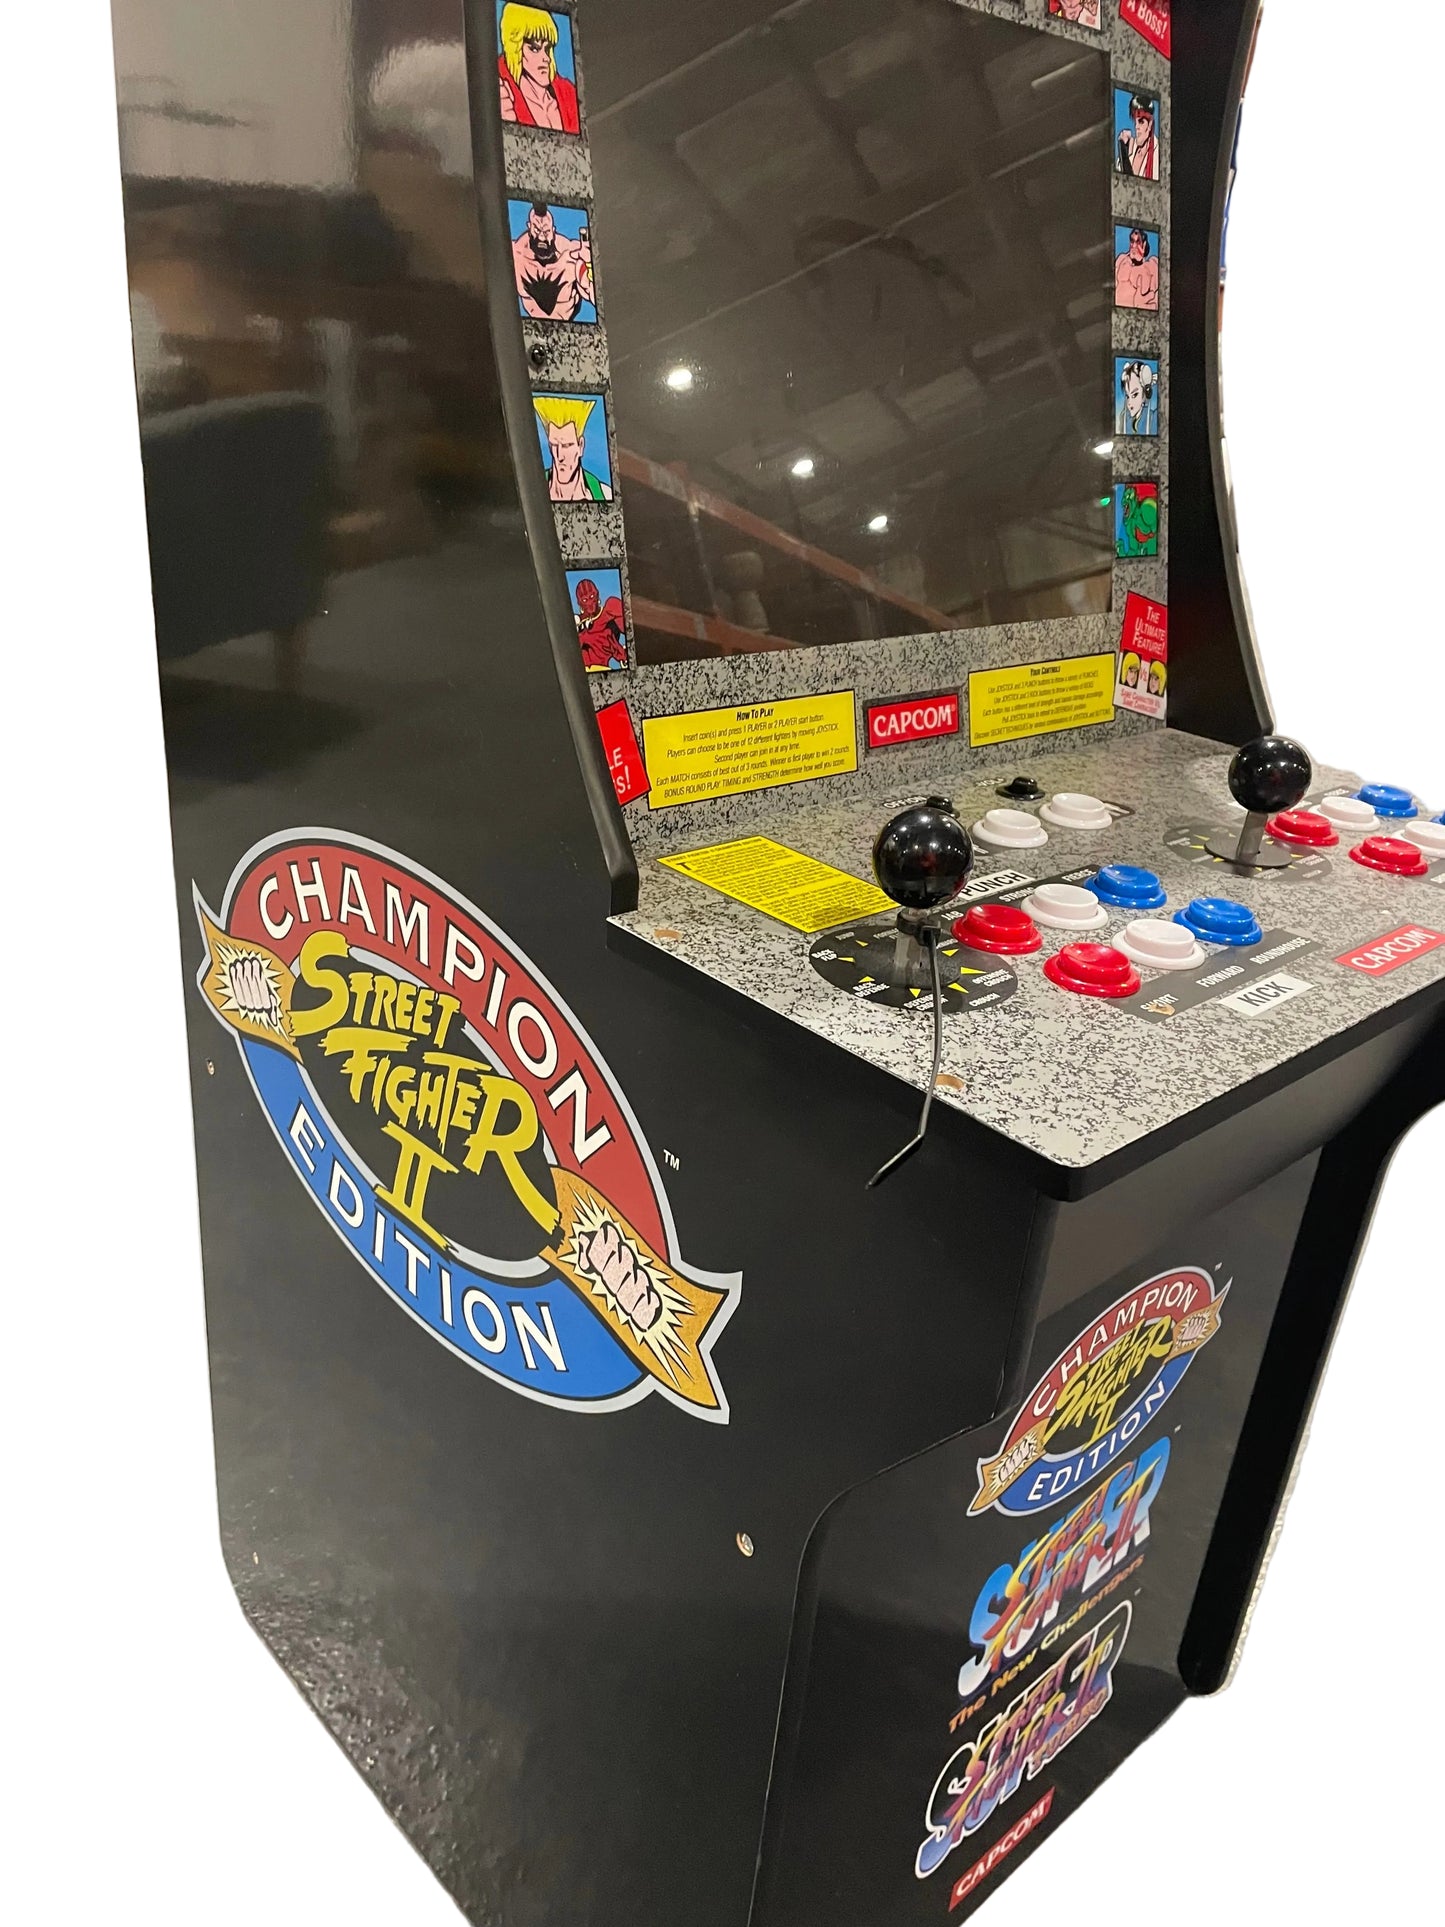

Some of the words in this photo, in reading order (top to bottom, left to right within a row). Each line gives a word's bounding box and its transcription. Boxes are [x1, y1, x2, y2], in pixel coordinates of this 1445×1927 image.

[1137, 1, 1168, 39] BOSS!
[1146, 606, 1160, 624] THE
[1135, 617, 1166, 641] ULTIMATE
[1132, 631, 1166, 656] FEATURE!
[683, 732, 698, 742] Insert
[699, 729, 717, 740] coin(s)
[717, 728, 728, 737] and
[728, 727, 742, 738] press
[747, 721, 767, 732] PLAYER
[773, 720, 778, 728] 2
[778, 717, 798, 727] PLAYER
[798, 716, 809, 724] start
[667, 748, 686, 759] Players
[686, 747, 696, 755] can
[697, 744, 715, 753] choose
[722, 741, 729, 749] be
[729, 740, 739, 748] one
[740, 738, 747, 746] of
[747, 737, 753, 745] 12
[753, 734, 773, 744] different
[773, 731, 791, 741] fighters
[791, 730, 797, 739] by
[798, 727, 816, 736] moving
[714, 753, 734, 763] Second
[734, 750, 749, 760] player
[749, 749, 758, 757] can
[779, 744, 788, 753] any
[656, 776, 669, 787] Each
[670, 772, 690, 783] MATCH
[690, 770, 712, 780] consists
[712, 768, 719, 776] of
[719, 766, 730, 775] best
[730, 765, 739, 773] out
[739, 764, 746, 772] of
[769, 757, 786, 766] Winner
[792, 753, 801, 762] first
[801, 751, 815, 761] player
[821, 749, 830, 757] win
[830, 747, 834, 755] 2
[664, 786, 685, 798] BONUS
[685, 783, 706, 794] ROUND
[722, 776, 742, 787] TIMING
[741, 774, 752, 783] and
[752, 769, 779, 782] STRENGTH
[779, 767, 802, 777] determine
[803, 764, 813, 773] how
[814, 761, 823, 770] well
[823, 761, 832, 770] you
[961, 871, 1029, 897] PUNCH
[1061, 868, 1097, 883] FIERCE
[941, 910, 964, 921] JAB
[811, 948, 834, 960] BACK
[822, 952, 838, 962] FLIP
[1249, 936, 1312, 965] ROUNDHOUSE
[1351, 929, 1437, 969] CAPCOM
[853, 981, 878, 992] BACK
[972, 968, 1009, 985] OFFENSIVE
[984, 973, 1014, 987] CROUCH
[1195, 965, 1245, 988] FORWARD
[289, 931, 461, 1049] STREET
[854, 983, 891, 998] DEFENSE
[969, 993, 1001, 1007] CROUCH
[1236, 981, 1294, 1007] KICK
[259, 859, 612, 1165] CHAMPION
[319, 1027, 562, 1235] FIGHTER
[663, 1148, 680, 1171] TM
[373, 1120, 458, 1253] II
[288, 1102, 568, 1373] EDITION
[1033, 1281, 1198, 1417] CHAMPION
[1056, 1318, 1145, 1411] STREET
[1042, 1315, 1172, 1445] FIGHTER
[1027, 1381, 1165, 1501] EDITION
[949, 1695, 987, 1733] The
[991, 1648, 1037, 1696] New
[1041, 1554, 1145, 1651] Challengers
[956, 1801, 1048, 1897] CAPCOM
